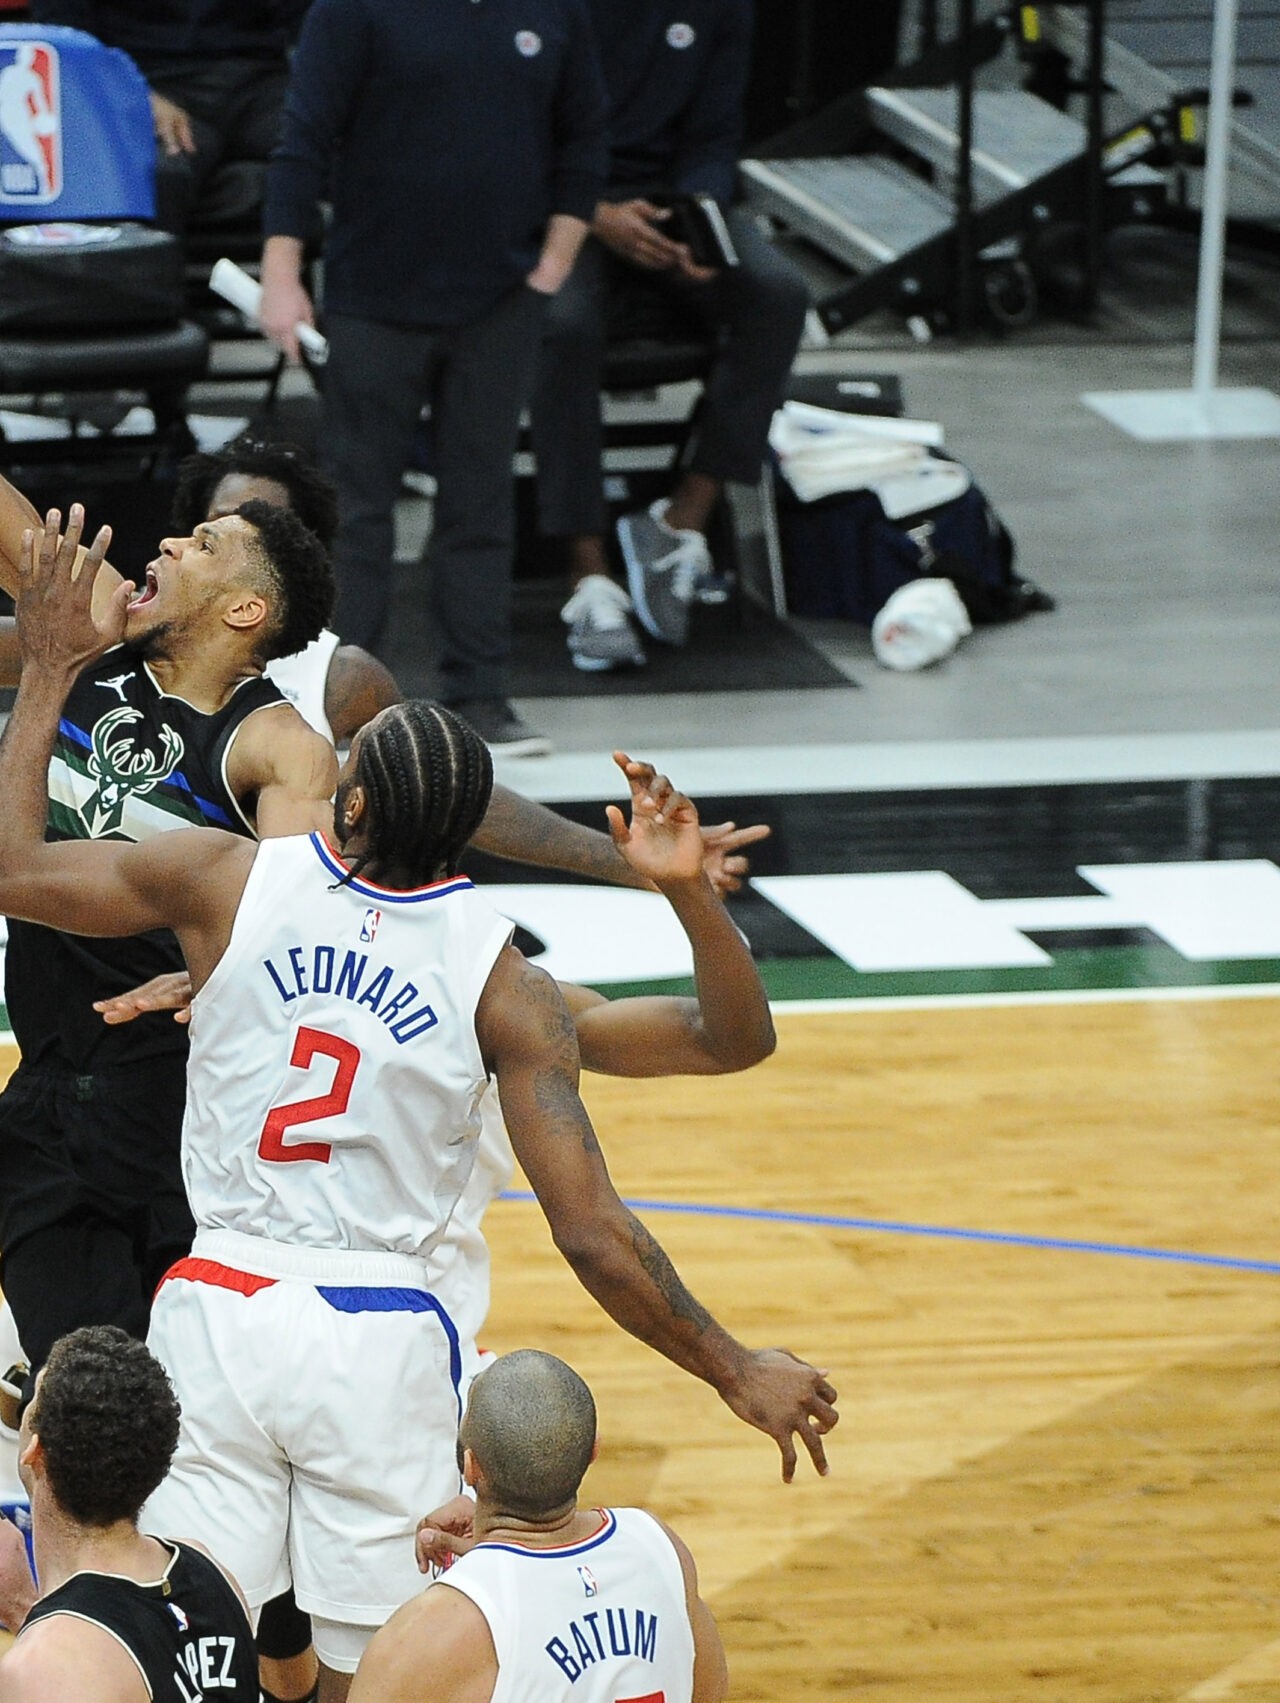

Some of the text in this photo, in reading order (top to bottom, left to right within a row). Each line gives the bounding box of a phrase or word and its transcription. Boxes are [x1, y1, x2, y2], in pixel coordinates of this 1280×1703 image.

[263, 945, 439, 1045] LEONARD
[257, 1025, 361, 1164] 2
[173, 1636, 237, 1703] LPEZ
[545, 1608, 658, 1684] BATUM
